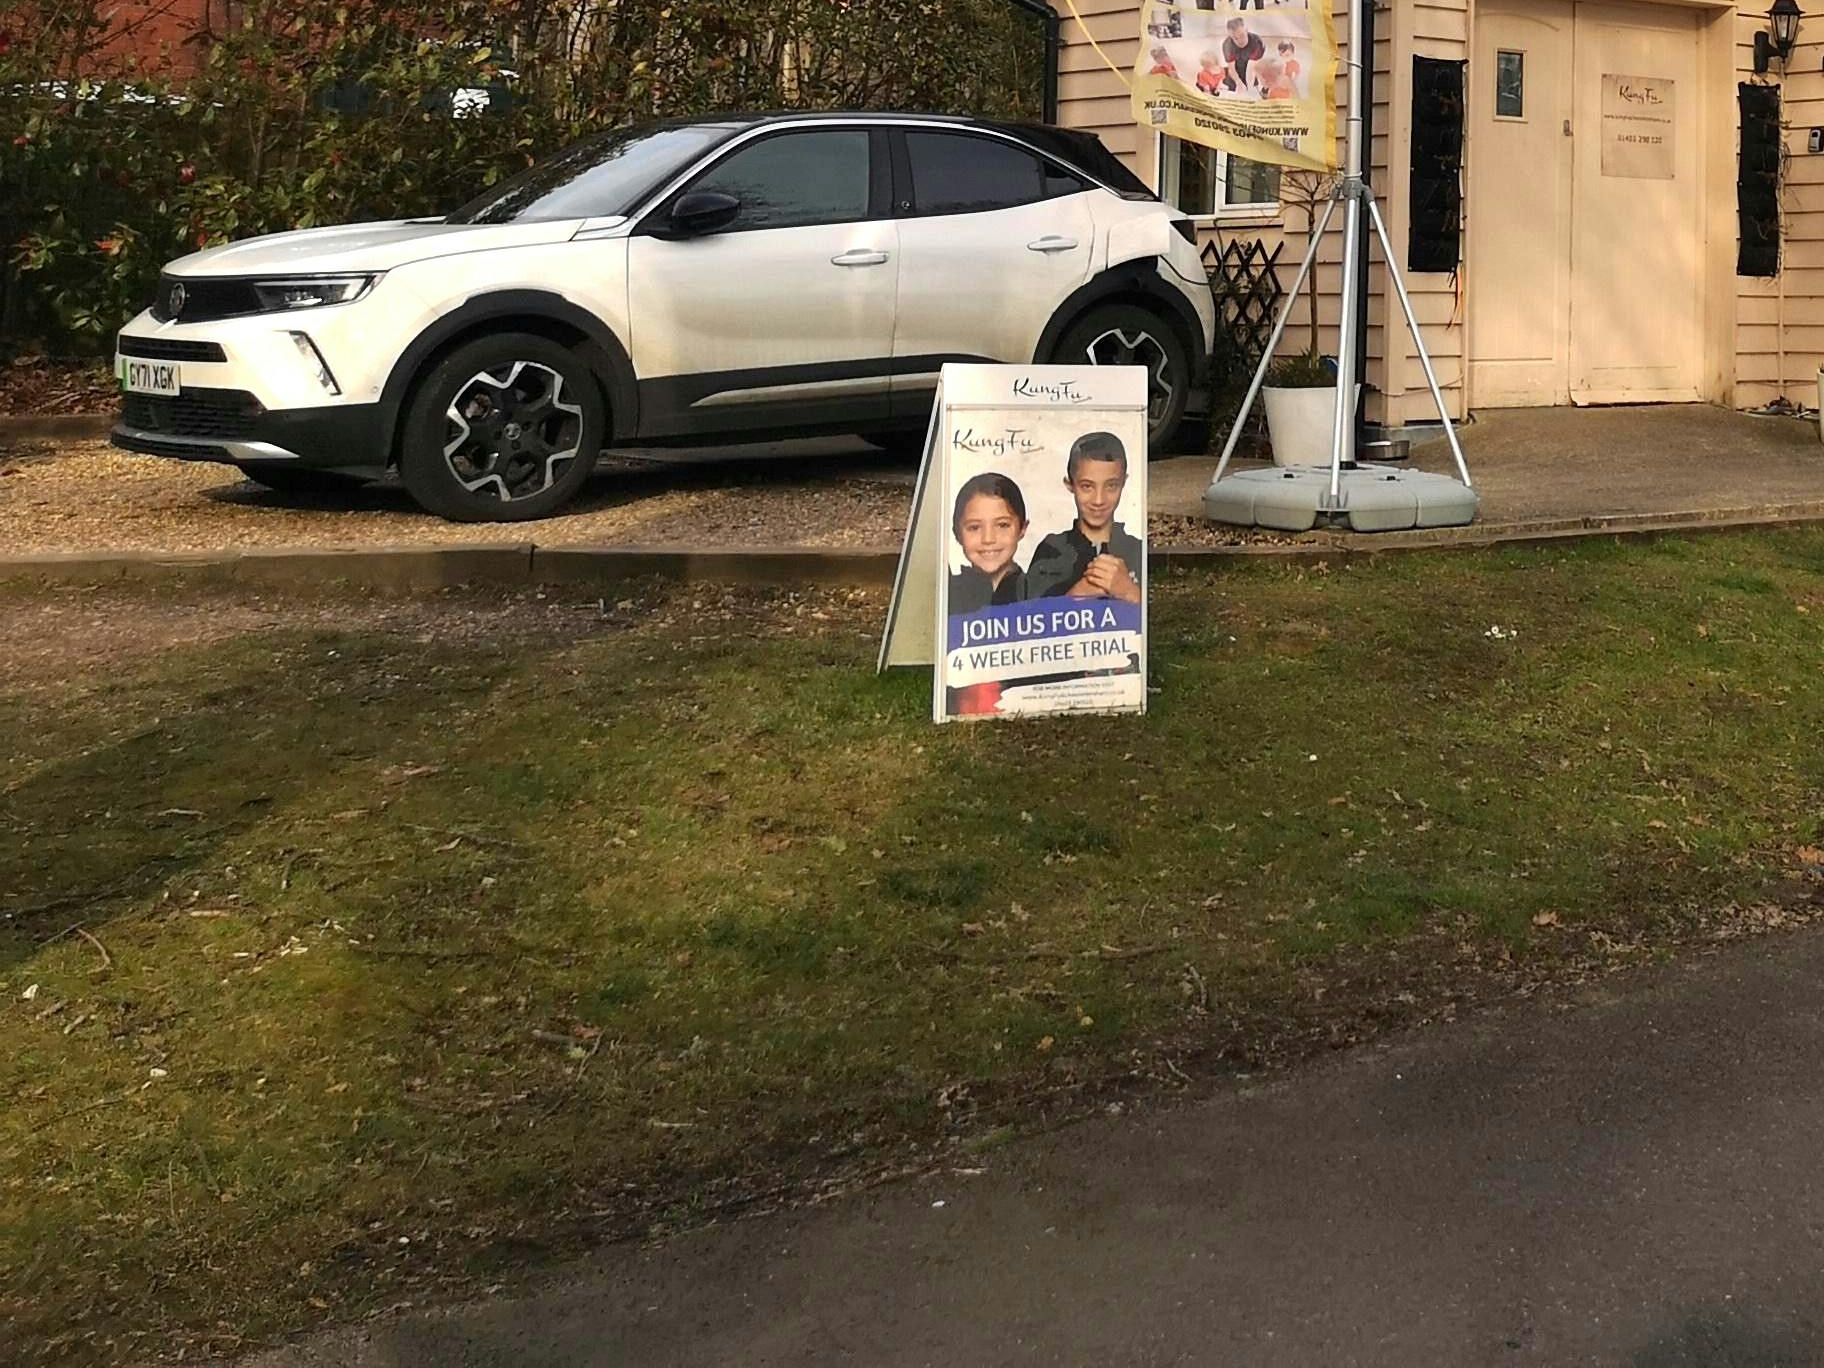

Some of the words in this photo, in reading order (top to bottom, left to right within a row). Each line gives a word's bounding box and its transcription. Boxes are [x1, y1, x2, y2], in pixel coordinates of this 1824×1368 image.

[130, 363, 150, 388] GY71
[152, 365, 175, 390] XGK
[961, 617, 1009, 647] JOIN
[1016, 614, 1045, 635] US
[1052, 609, 1095, 633] FOR
[1101, 607, 1117, 628] A
[952, 656, 964, 671] 4
[970, 647, 1023, 669] WEEK
[1030, 642, 1074, 664] FREE
[1080, 637, 1131, 658] TRIAL
